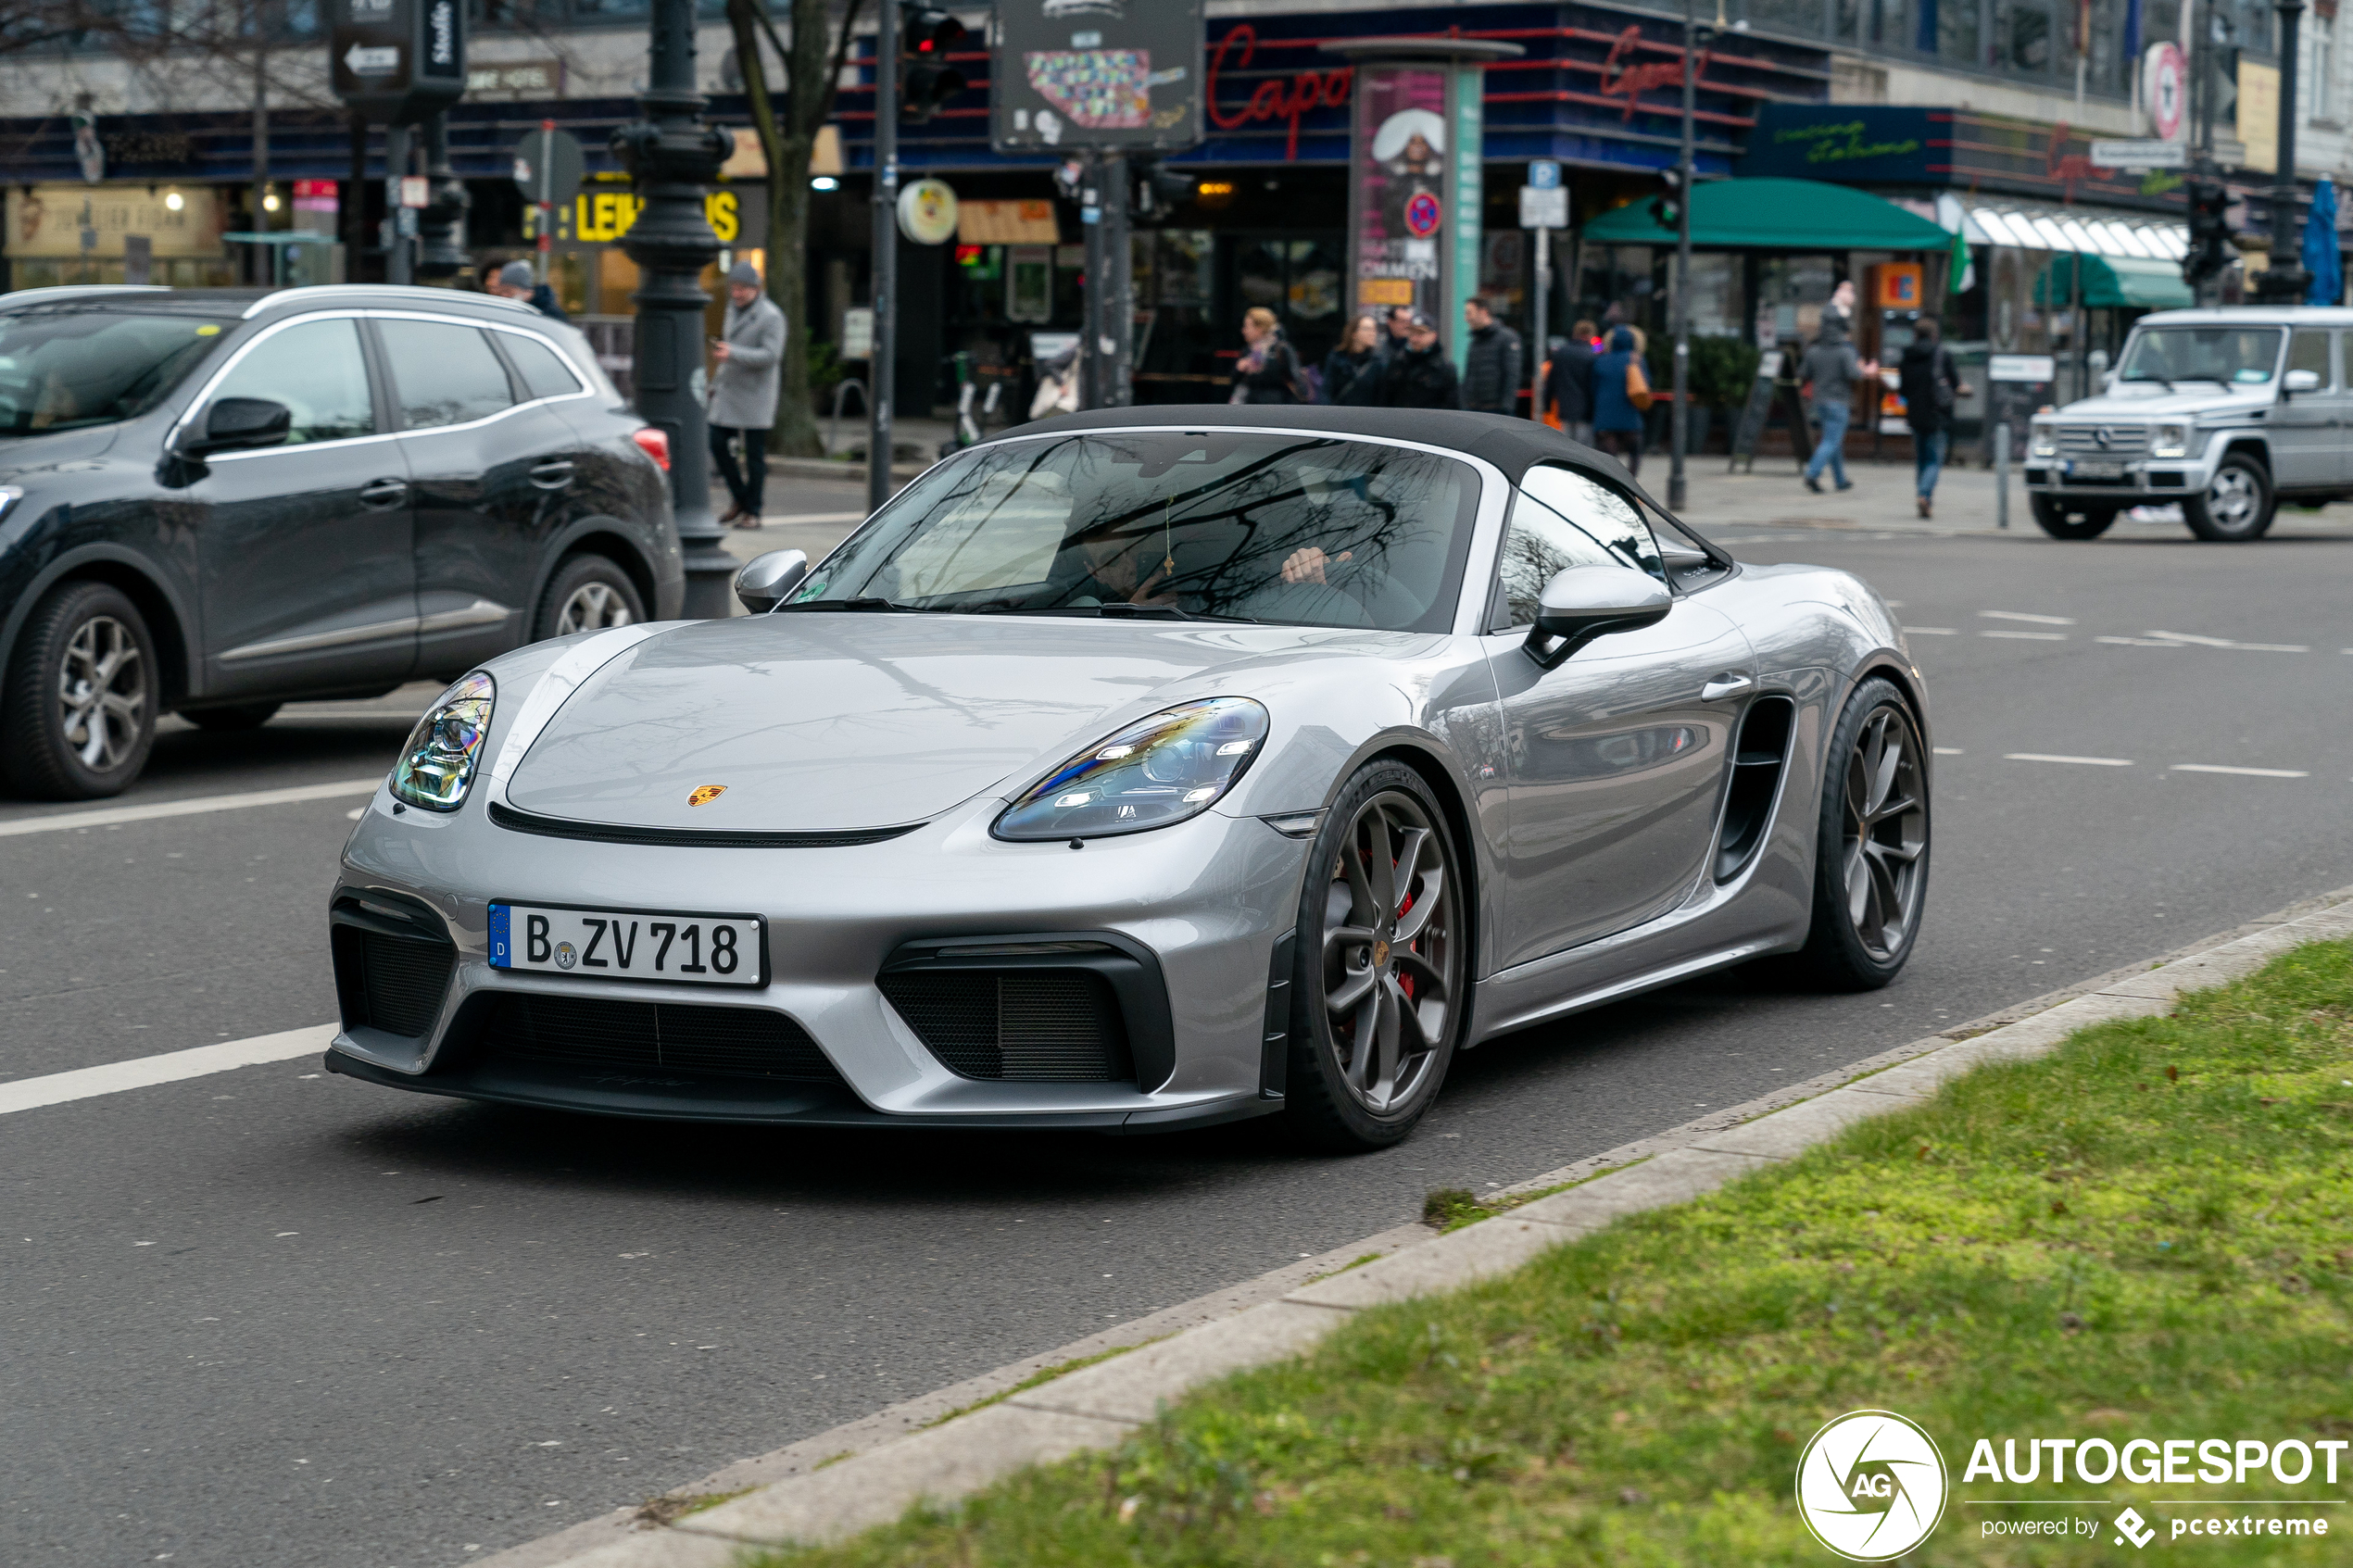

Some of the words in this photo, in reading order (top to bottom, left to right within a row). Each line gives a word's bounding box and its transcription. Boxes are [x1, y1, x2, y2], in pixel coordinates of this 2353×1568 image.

[497, 942, 506, 957] D
[527, 913, 552, 963] B
[582, 918, 639, 969] ZV
[650, 922, 739, 974] 718
